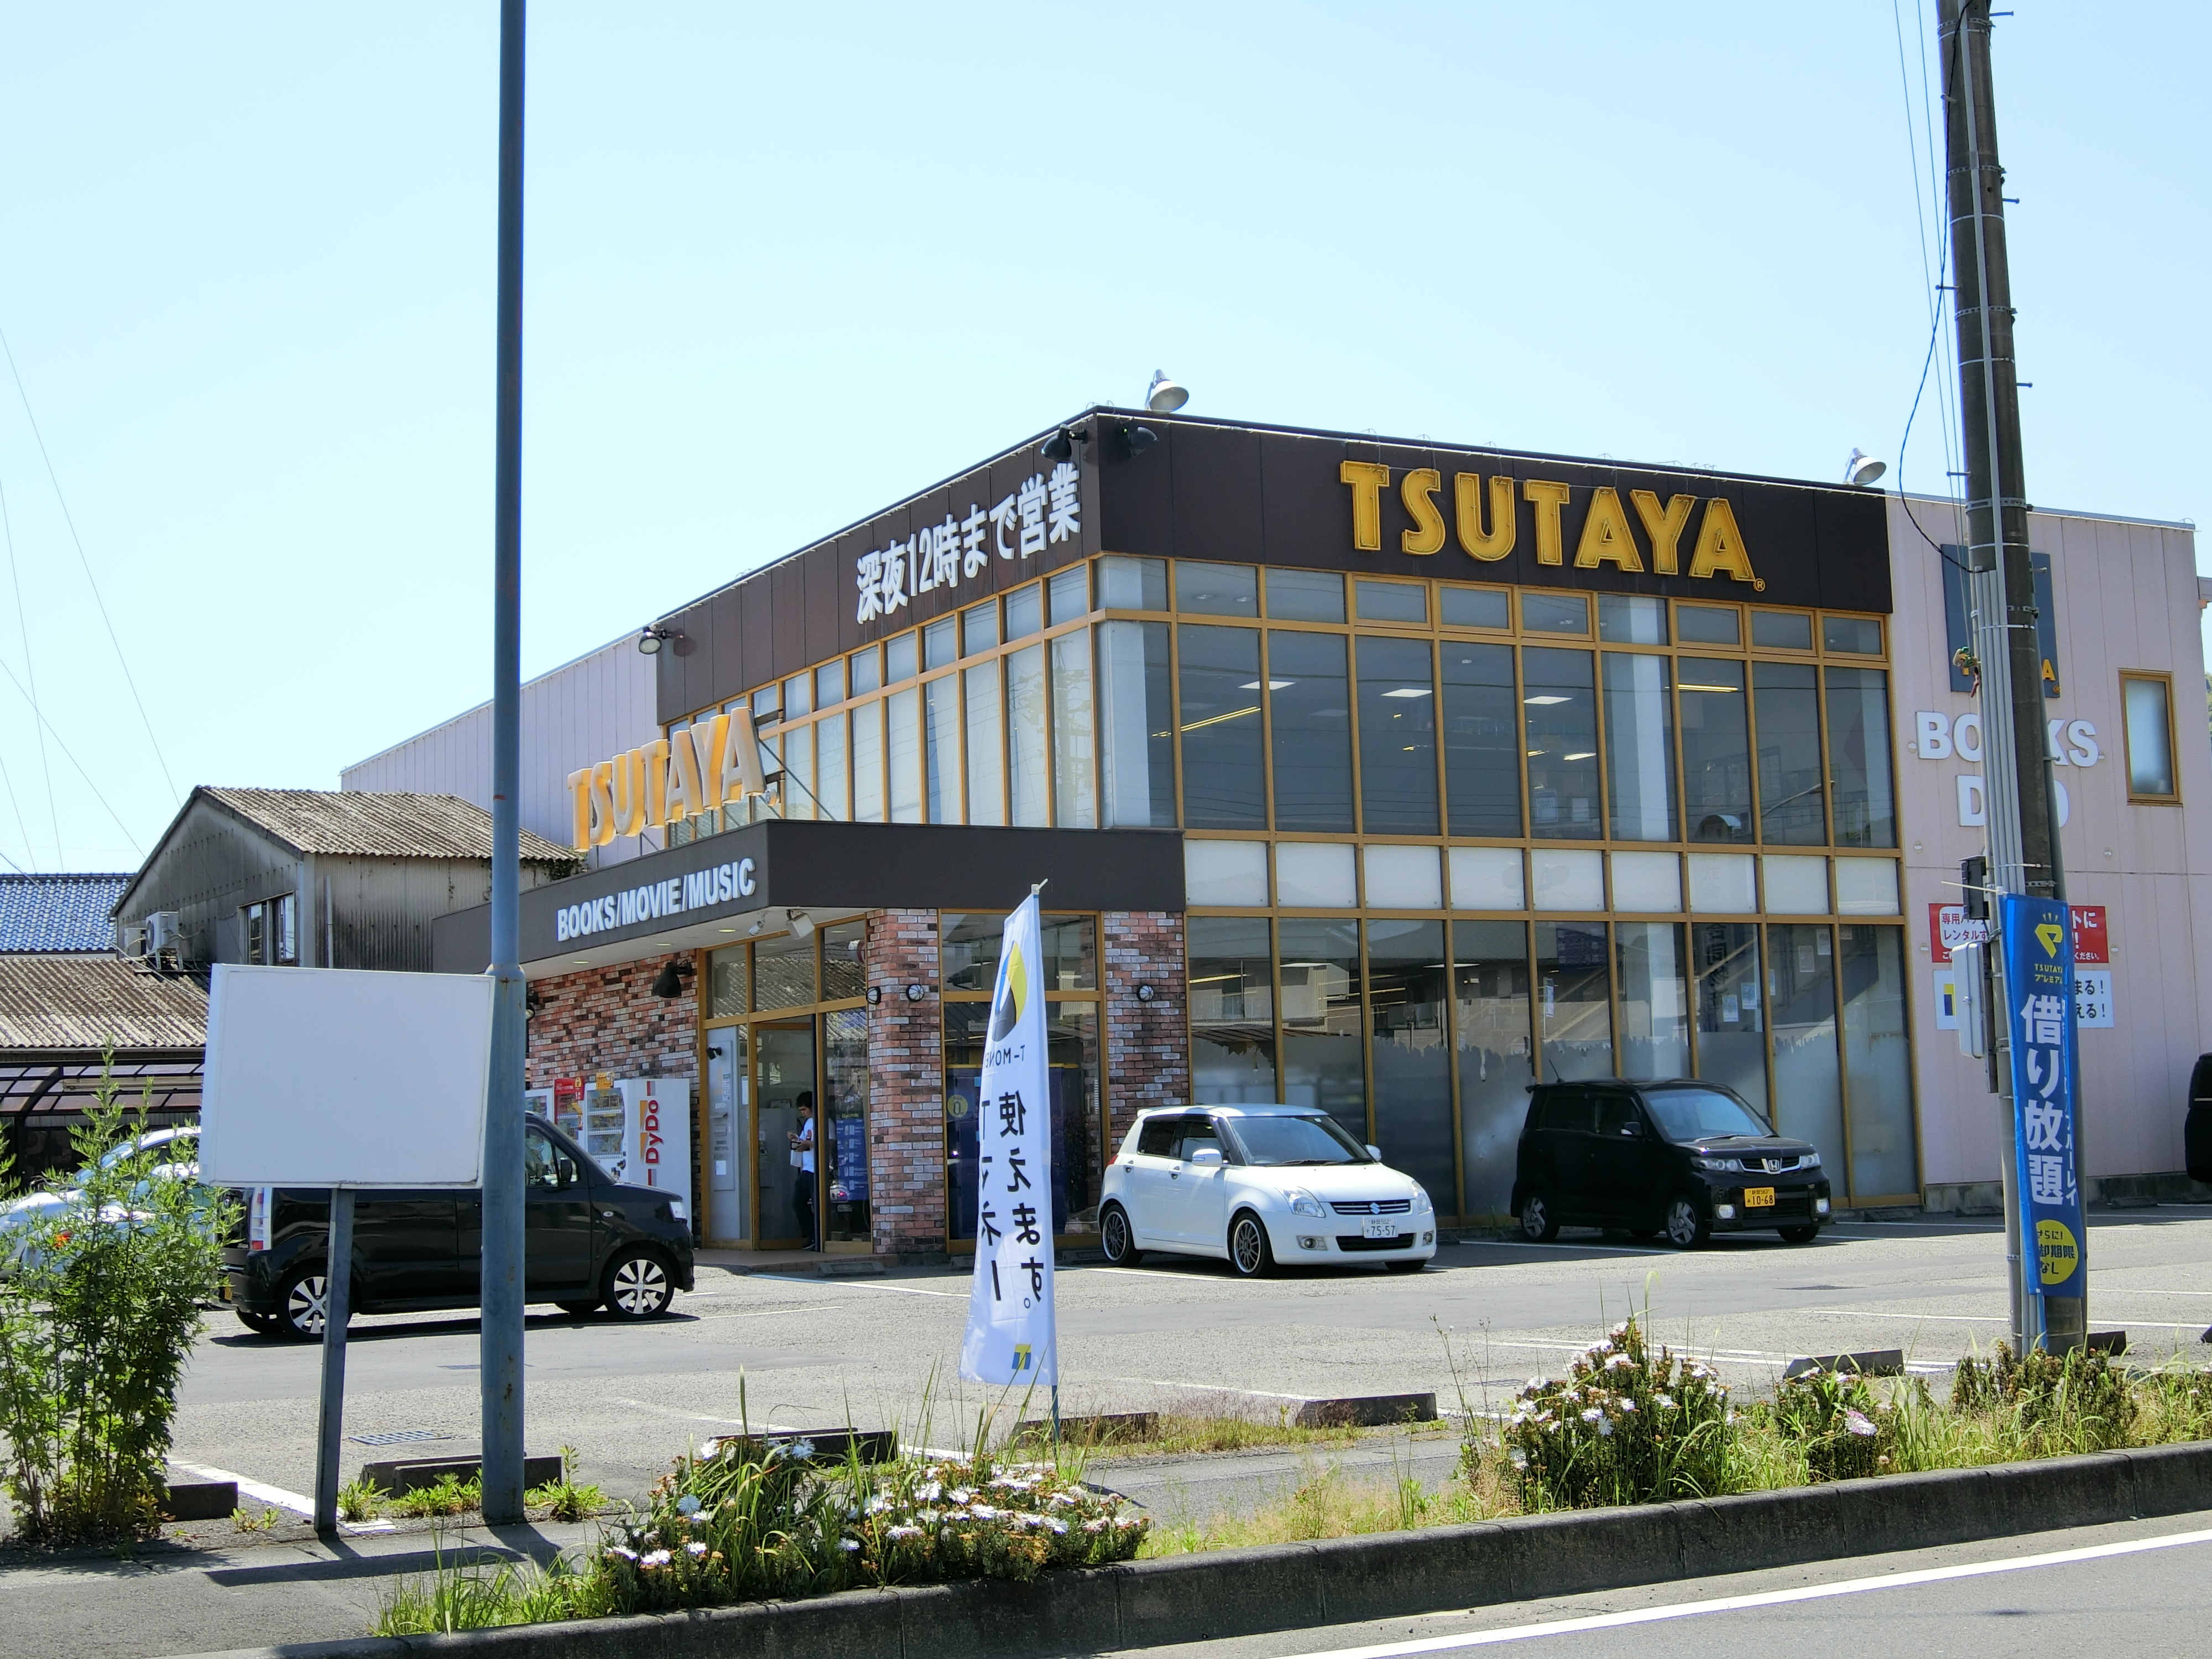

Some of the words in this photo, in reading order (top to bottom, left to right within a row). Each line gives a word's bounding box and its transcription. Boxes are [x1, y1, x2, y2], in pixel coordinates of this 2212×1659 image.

[857, 462, 1081, 624] 深夜12時まで営業
[1916, 711, 2099, 768] BOKS
[557, 858, 756, 942] BOOKS/MOVIE/MUSIC
[2020, 994, 2063, 1206] 借り放題
[1371, 1225, 1395, 1236] 75-57
[1752, 1194, 1773, 1205] 10-68
